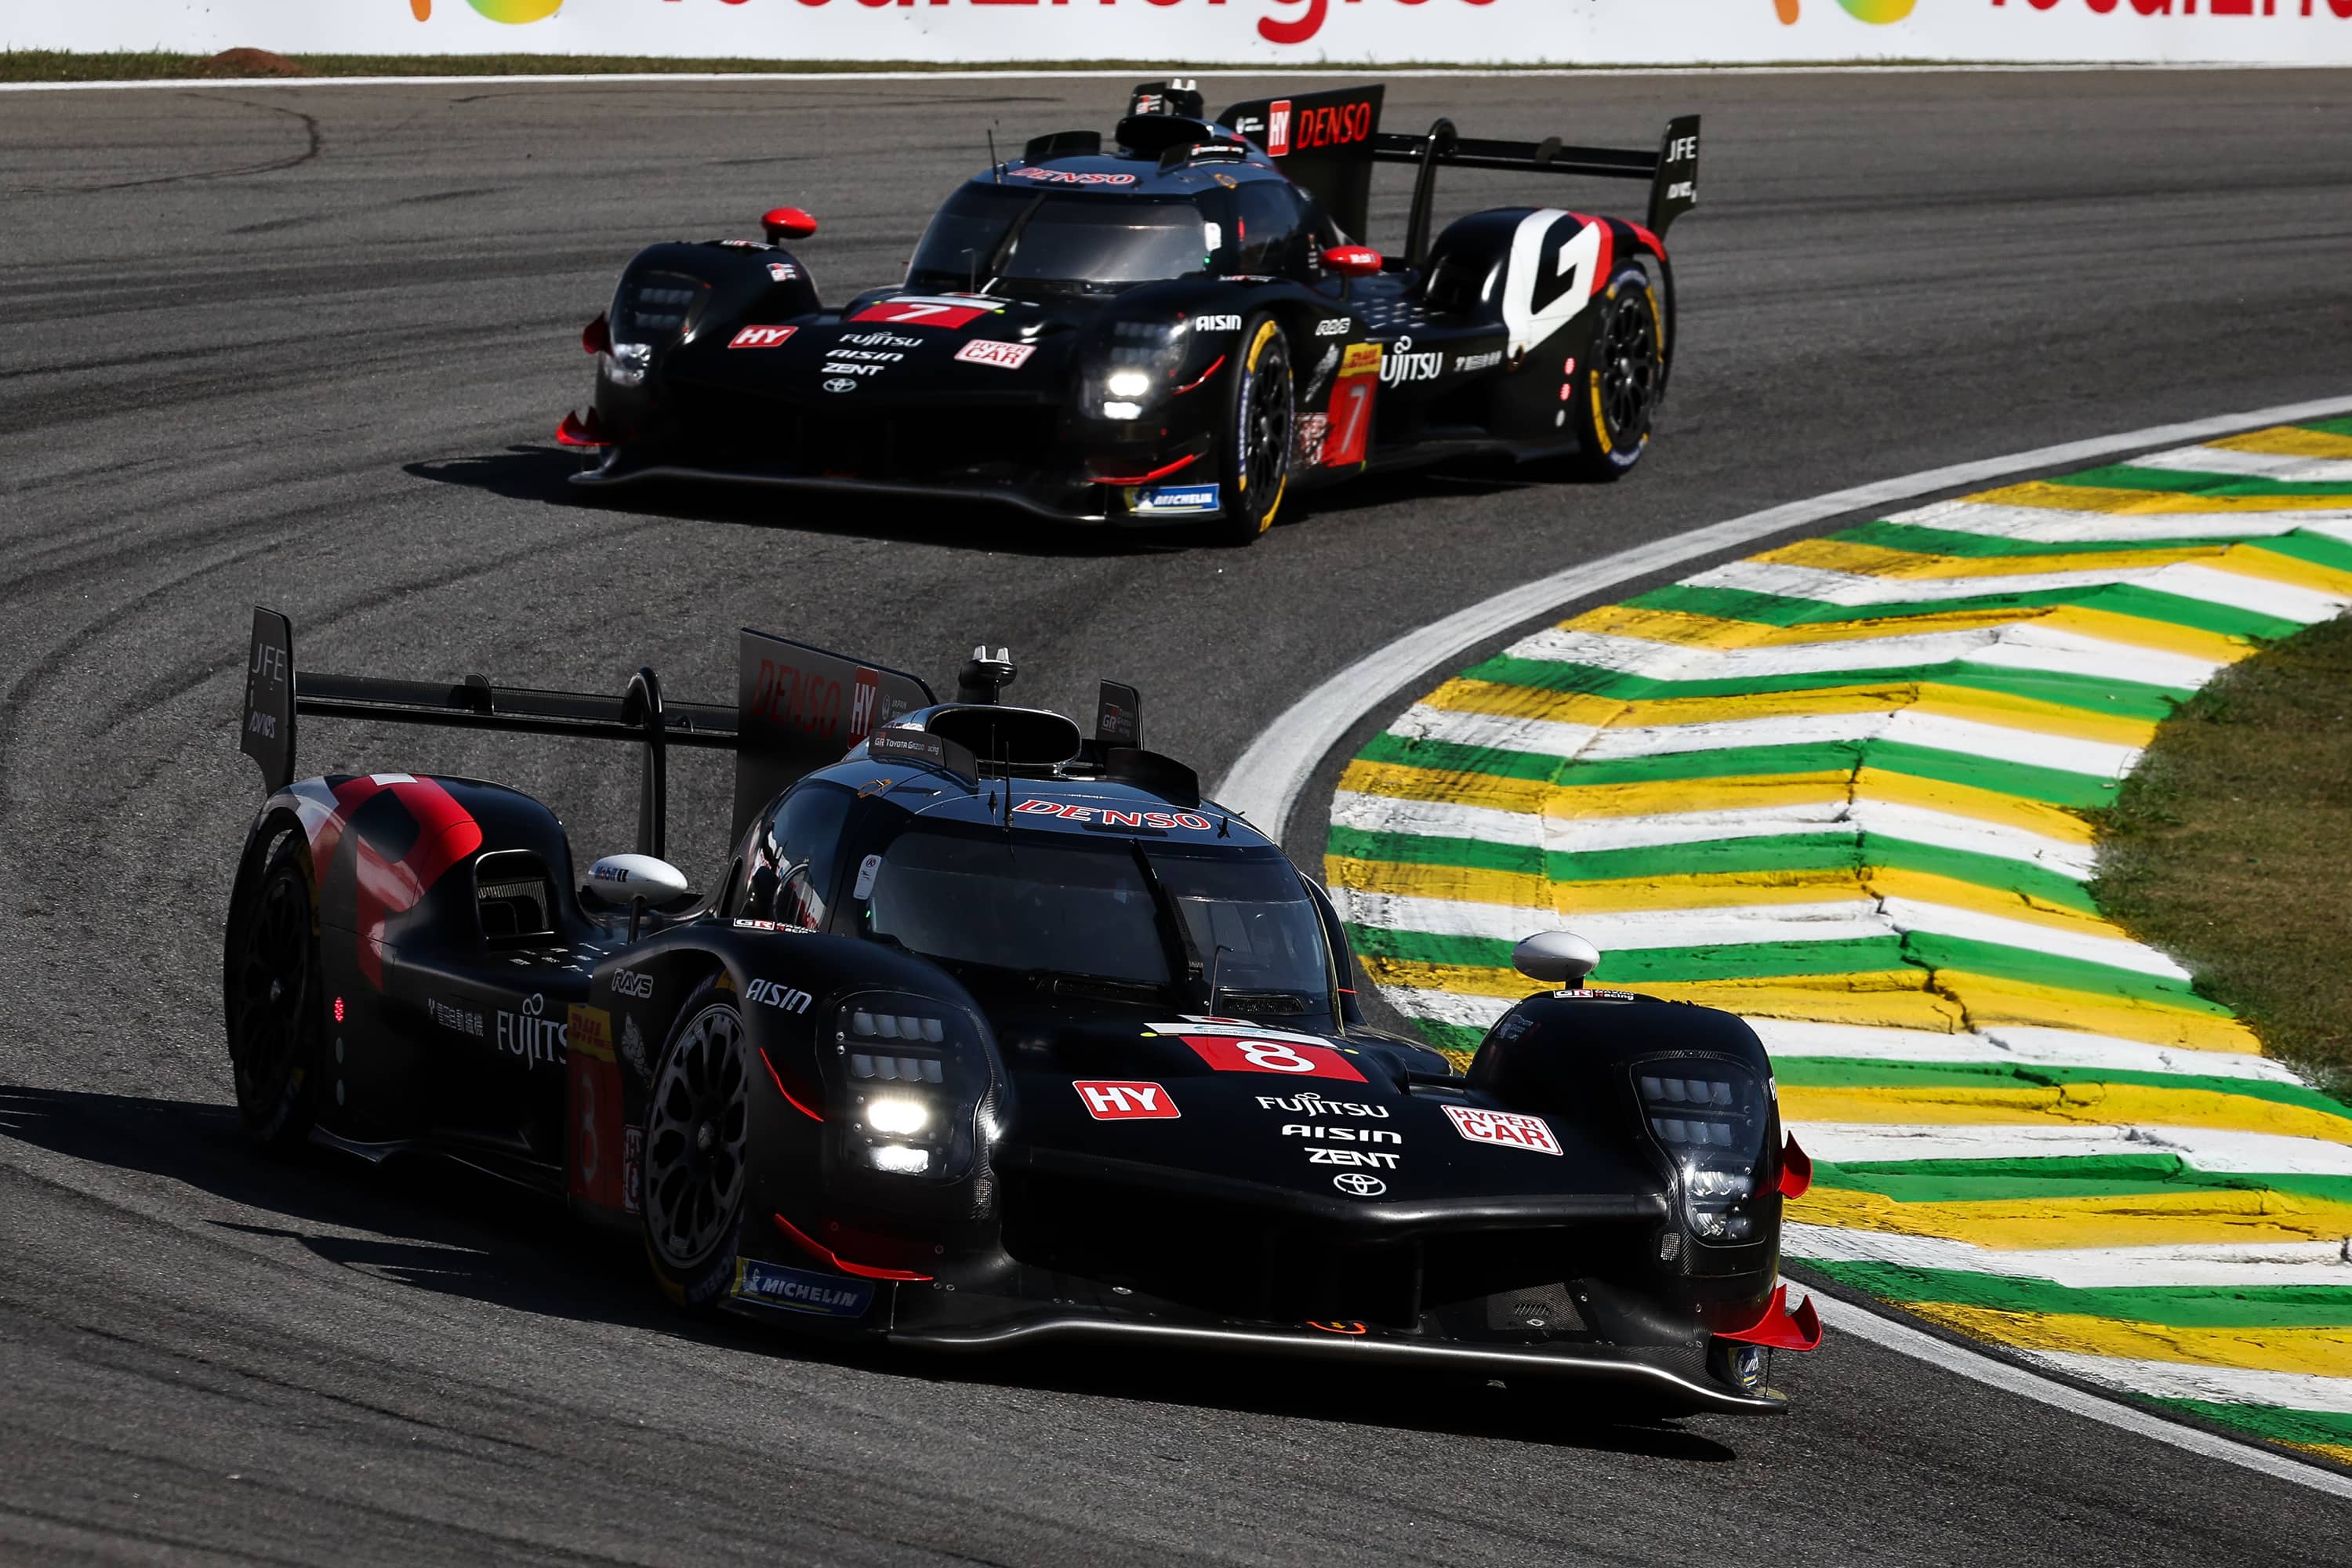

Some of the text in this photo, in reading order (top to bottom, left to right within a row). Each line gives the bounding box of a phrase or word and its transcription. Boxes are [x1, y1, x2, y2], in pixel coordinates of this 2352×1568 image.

[1269, 111, 1290, 147] HY
[1296, 102, 1371, 150] DENSO
[1665, 136, 1697, 162] JFE
[1007, 167, 1136, 185] DENSO
[886, 303, 952, 321] 7
[1196, 314, 1243, 332] AISIN
[735, 328, 791, 345] HY
[838, 331, 924, 347] FUJITSU
[974, 341, 1027, 353] HYPER
[825, 349, 905, 362] AISIN
[965, 347, 1019, 364] CAR
[1380, 335, 1443, 390] UJITSU
[821, 362, 885, 376] ZENT
[1341, 385, 1366, 455] 7
[251, 642, 286, 682] JFE
[753, 658, 842, 740] DENSO
[850, 682, 877, 737] HY
[1103, 714, 1118, 730] GR
[874, 737, 885, 747] GR
[1011, 799, 1212, 830] DENSO
[735, 918, 775, 929] GR
[612, 967, 654, 1000] RAYS
[746, 978, 813, 1015] AISIN
[497, 993, 568, 1072] FUJITS
[1236, 1040, 1316, 1073] 8
[1082, 1086, 1159, 1112] HY
[1254, 1092, 1390, 1119] FUJITSU
[1452, 1109, 1541, 1130] HYPER
[1281, 1124, 1403, 1145] AISIN
[1462, 1120, 1552, 1149] CAR
[1304, 1147, 1400, 1170] ZENT
[760, 1276, 861, 1308] MICHELIN
